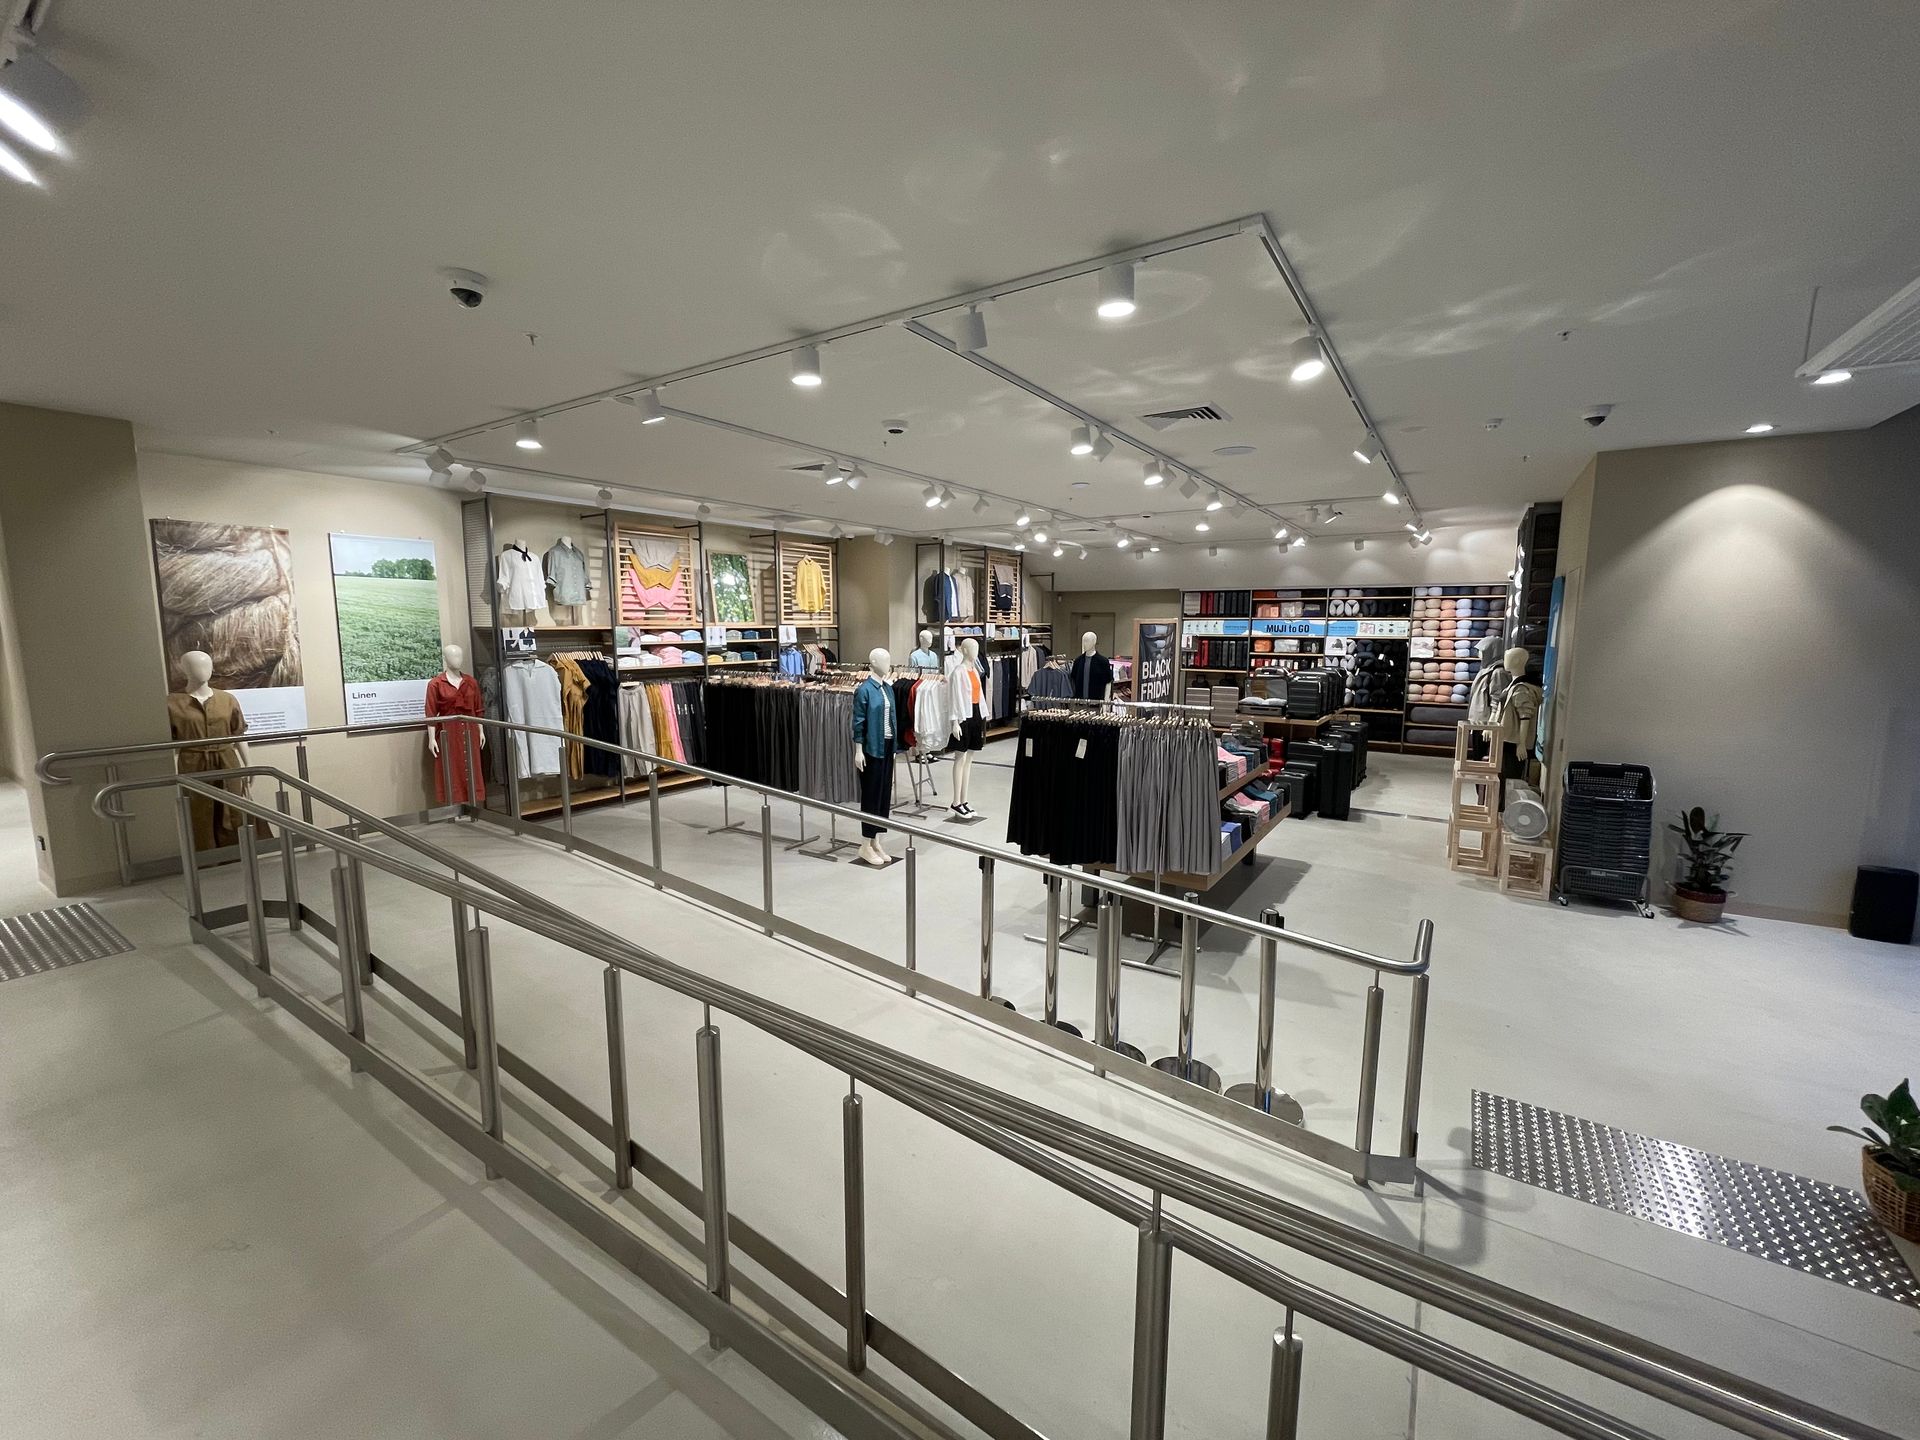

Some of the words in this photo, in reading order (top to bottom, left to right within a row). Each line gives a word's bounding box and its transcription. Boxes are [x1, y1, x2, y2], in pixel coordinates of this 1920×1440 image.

[1266, 624, 1286, 633] MUJI
[1288, 624, 1297, 633] to
[1298, 624, 1310, 633] GO
[1142, 659, 1171, 680] BLACK
[1140, 680, 1170, 701] FRIDAY
